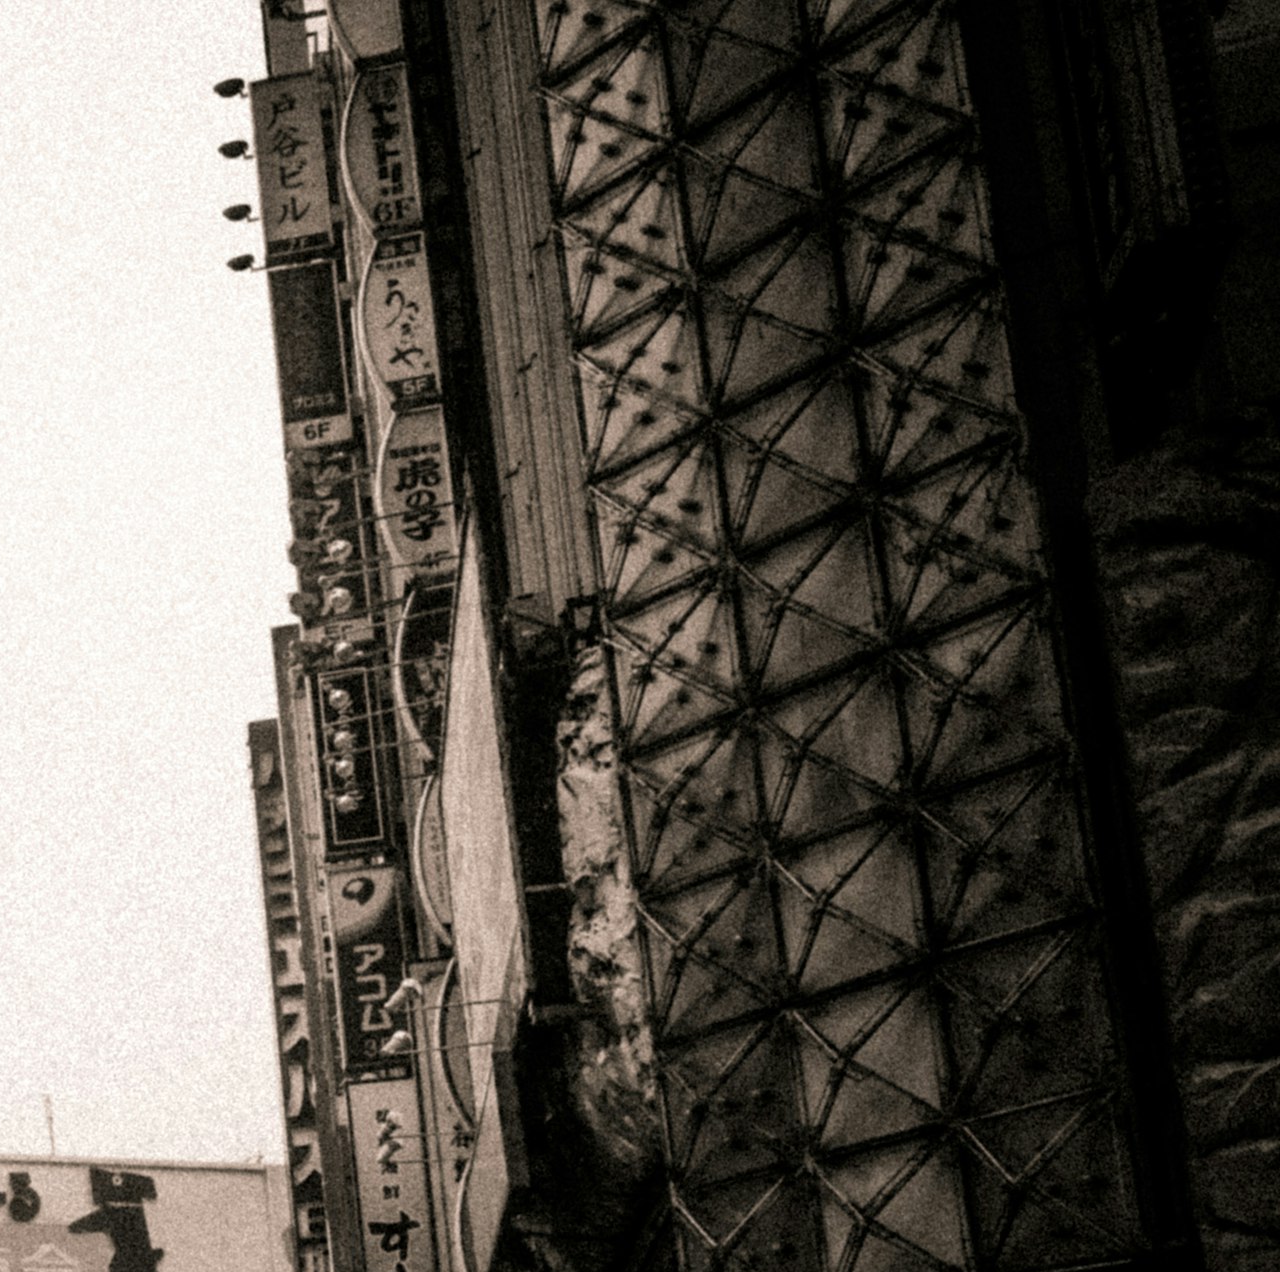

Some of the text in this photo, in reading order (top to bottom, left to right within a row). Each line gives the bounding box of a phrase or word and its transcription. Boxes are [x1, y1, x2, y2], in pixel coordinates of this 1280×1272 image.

[303, 422, 330, 441] 6F
[352, 943, 393, 1033] アコム
